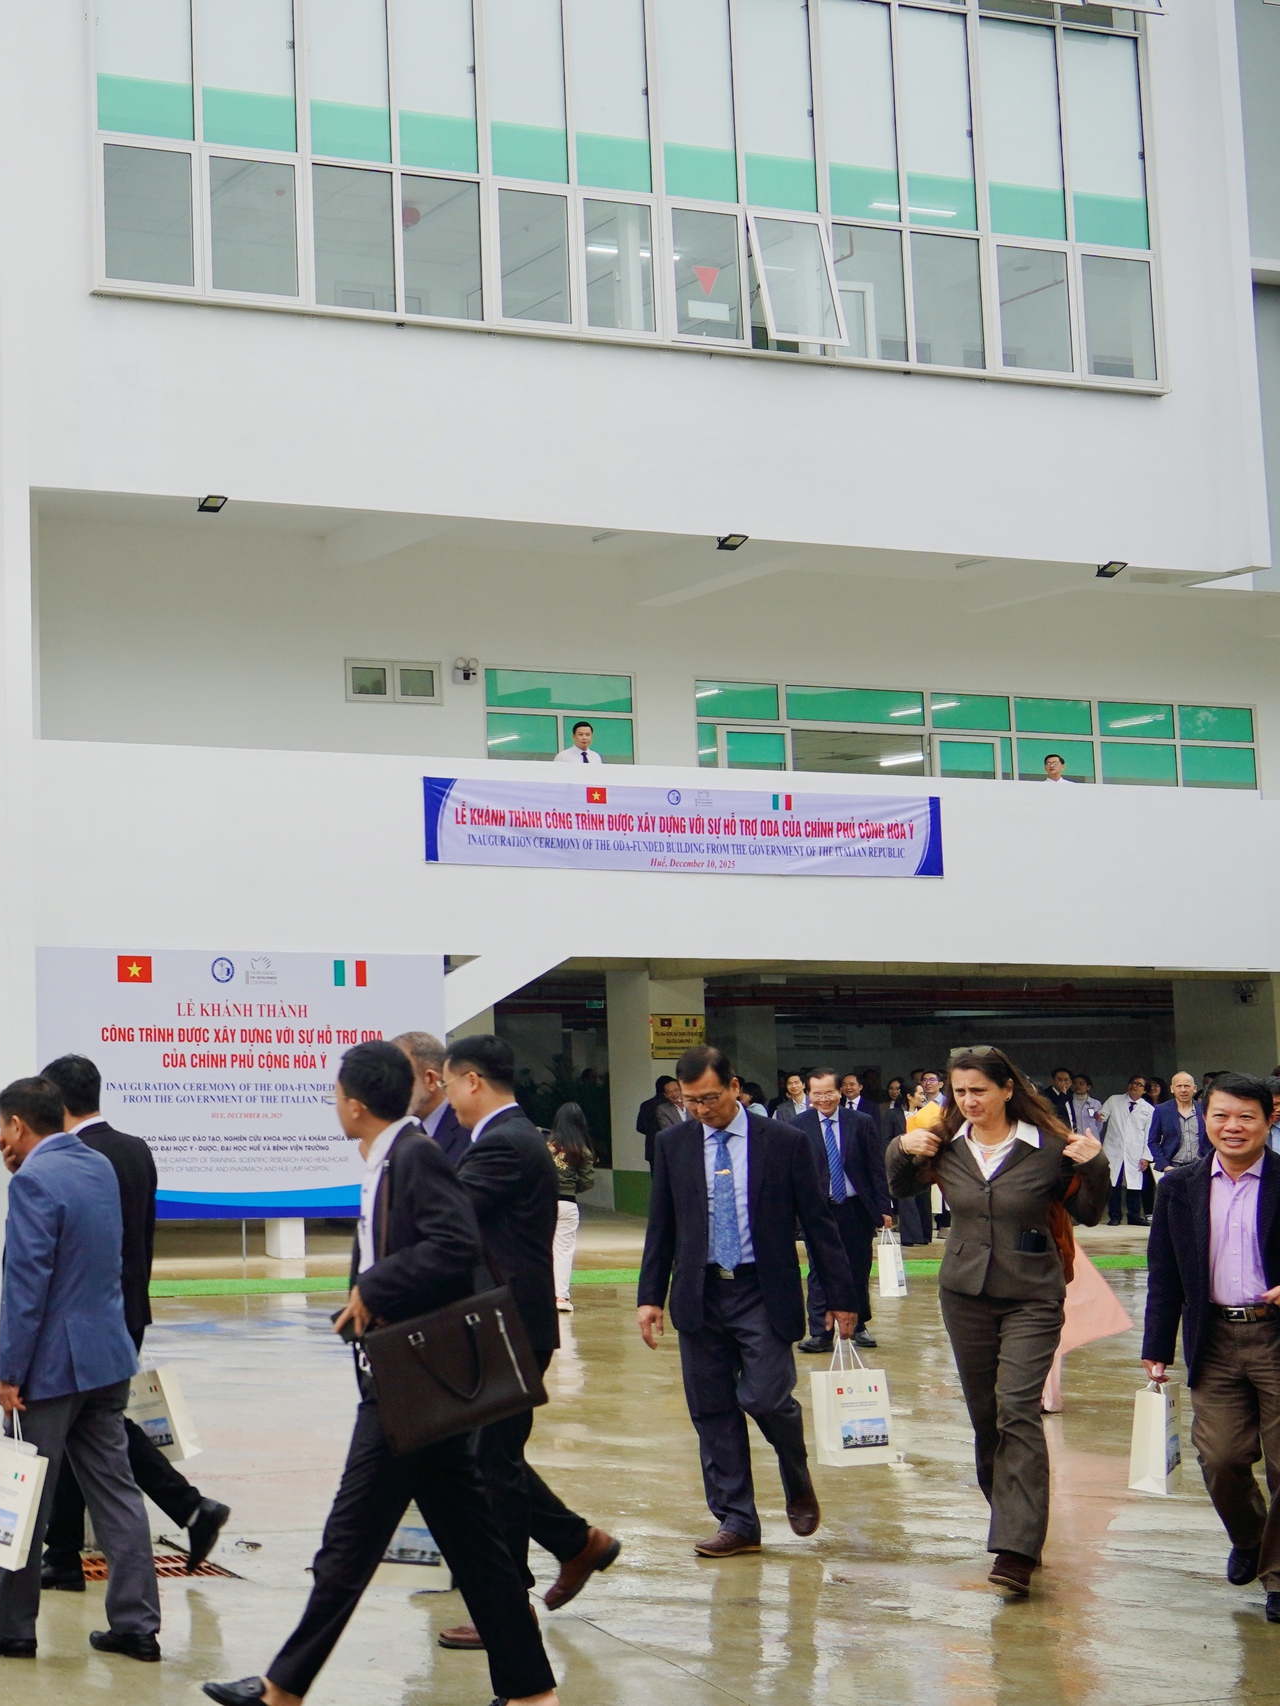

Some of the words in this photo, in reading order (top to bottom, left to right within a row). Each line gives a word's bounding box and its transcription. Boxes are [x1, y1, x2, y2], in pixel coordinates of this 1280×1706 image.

[455, 801, 468, 825] LỄ
[470, 805, 506, 827] KHÁNH
[508, 806, 543, 828] THÀNH
[545, 808, 573, 830] CÔNG
[575, 809, 605, 831] TRÌNH
[607, 812, 634, 836] ĐƯỢC
[637, 812, 656, 834] XÂY
[659, 814, 686, 838] DỰNG
[688, 814, 705, 835] VỚI
[708, 816, 722, 839] SỰ
[723, 812, 737, 836] HỖ
[740, 818, 758, 840] TRỢ
[760, 819, 780, 838] ODA
[782, 815, 802, 838] CỦA
[804, 818, 834, 839] CHÍNH
[836, 816, 856, 839] PHỦ
[858, 818, 885, 842] CỘNG
[887, 818, 907, 840] HÒA
[908, 819, 915, 840] Ý
[468, 834, 532, 848] INAUGURATION
[533, 836, 582, 850] CEREMONY
[583, 838, 593, 850] OF
[596, 839, 612, 851] THE
[613, 840, 664, 854] ODA-FUNDED
[666, 842, 705, 854] BUILDING
[706, 842, 730, 855] FROM
[730, 844, 748, 856] THE
[748, 844, 804, 857] GOVERNMENT
[806, 845, 818, 858] OF
[819, 846, 834, 858] THE
[835, 846, 868, 858] ITALIAN
[868, 846, 906, 859] REPUBLIC
[650, 856, 668, 868] Huế,
[670, 858, 704, 868] December
[706, 859, 718, 869] 10,
[719, 860, 736, 869] 2025
[177, 998, 196, 1016] LỄ
[200, 999, 253, 1018] KHÁNH
[257, 1000, 308, 1018] THÀNH
[102, 1024, 134, 1042] CÔNG
[138, 1024, 174, 1042] TRÌNH
[178, 1026, 210, 1046] ĐƯỢC
[214, 1026, 236, 1043] XÂY
[240, 1028, 272, 1047] DỰNG
[276, 1026, 294, 1044] VỚI
[298, 1028, 314, 1048] SỰ
[318, 1024, 332, 1044] HỖ
[336, 1028, 358, 1048] TRỢ
[163, 1048, 187, 1068] CỦA
[190, 1050, 226, 1068] CHÍNH
[230, 1049, 254, 1068] PHỦ
[258, 1051, 290, 1072] CỘNG
[294, 1050, 316, 1069] HÒA
[320, 1052, 327, 1069] Ý
[106, 1082, 180, 1091] INAUGURATION
[183, 1082, 236, 1092] CEREMONY
[239, 1083, 252, 1092] OF
[254, 1083, 272, 1092] THE
[274, 1083, 335, 1092] ODA-FUNDED
[123, 1094, 152, 1104] FROM
[154, 1094, 174, 1104] THE
[176, 1094, 244, 1104] GOVERNMENT
[246, 1095, 258, 1104] OF
[260, 1095, 279, 1104] THE
[281, 1095, 318, 1104] ITALIAN
[282, 1135, 296, 1143] HỌC
